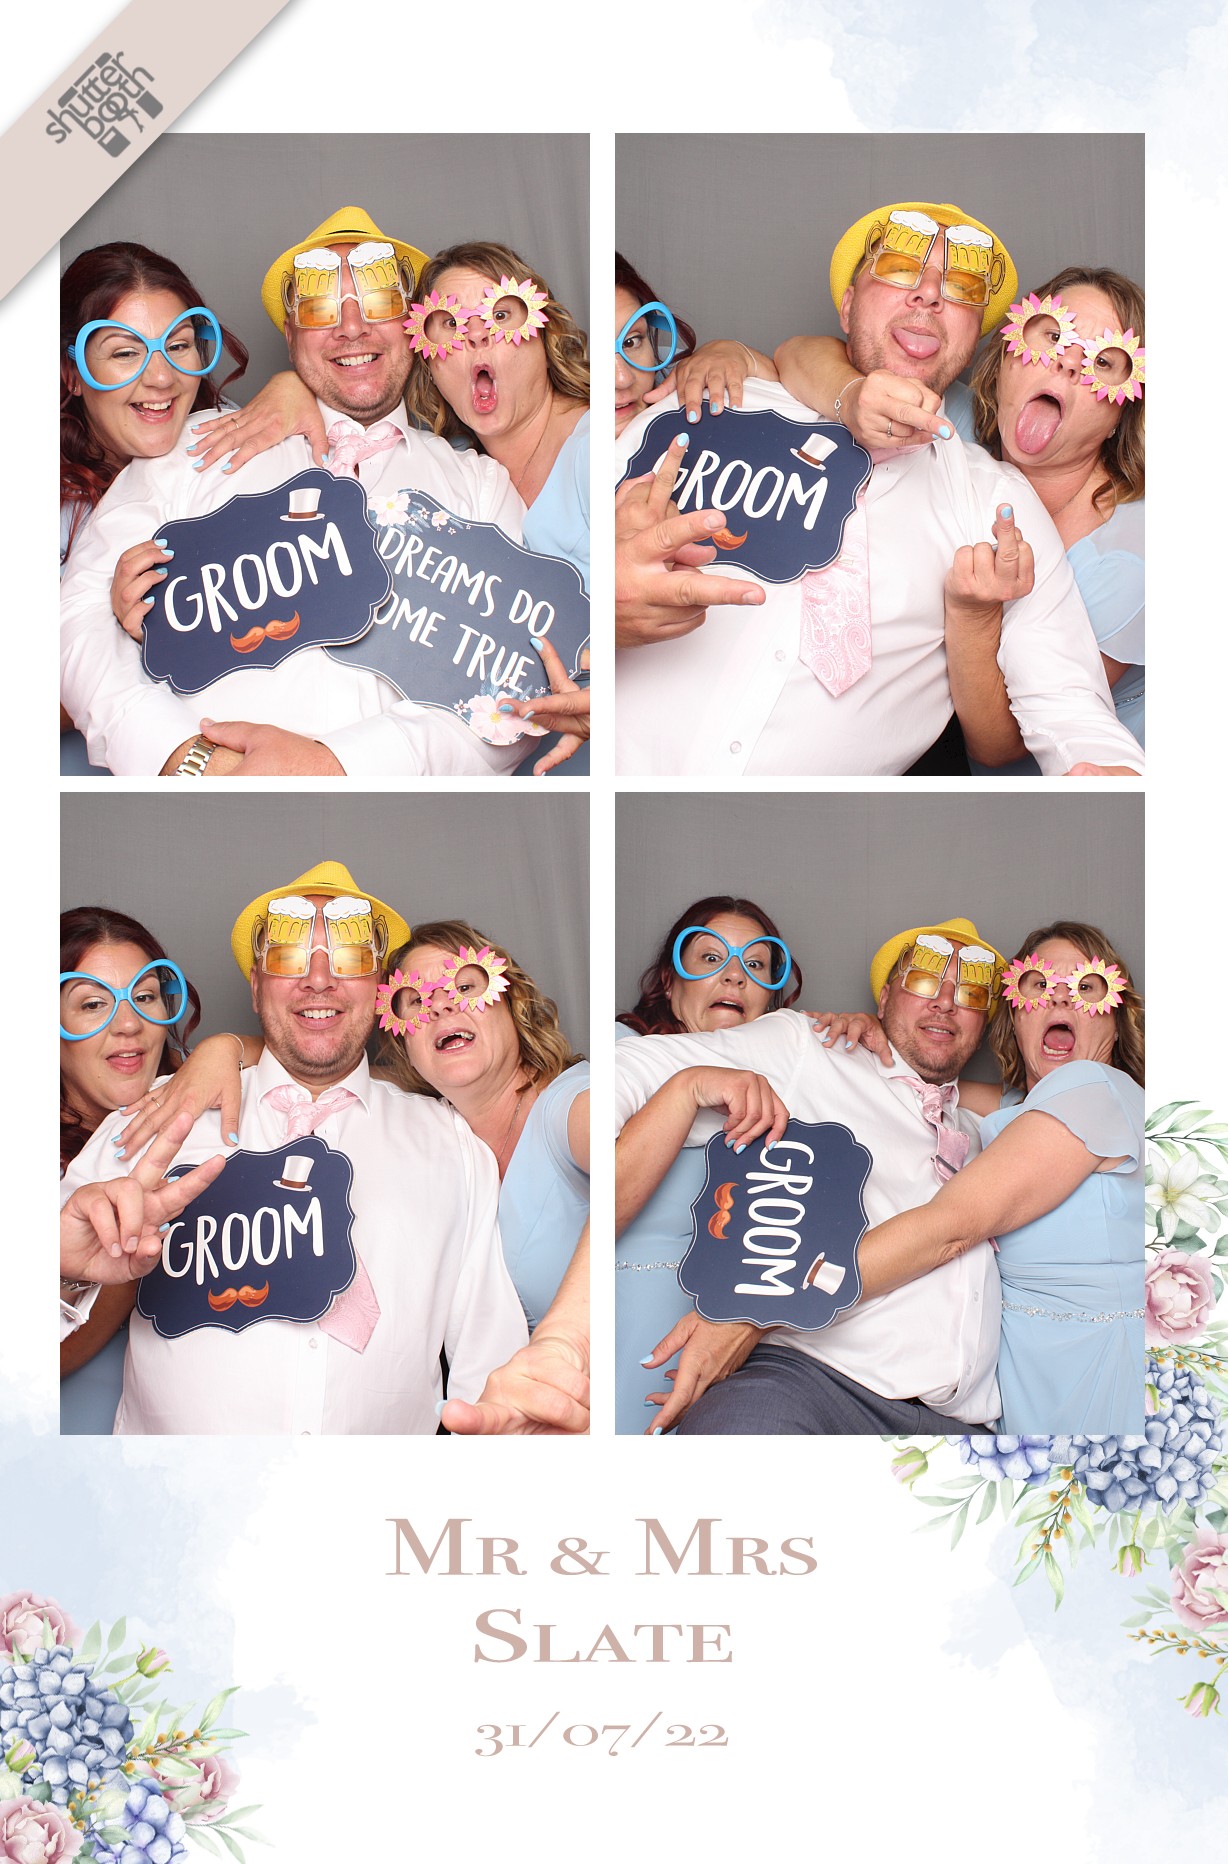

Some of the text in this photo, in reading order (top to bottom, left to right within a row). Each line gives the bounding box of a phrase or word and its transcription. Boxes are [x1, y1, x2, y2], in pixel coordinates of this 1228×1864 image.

[164, 522, 353, 633] GROOM
[378, 527, 555, 638] DREAMS DO
[374, 590, 535, 694] OME TRUE
[161, 1196, 325, 1286] GROOM
[734, 1140, 815, 1297] GROOM
